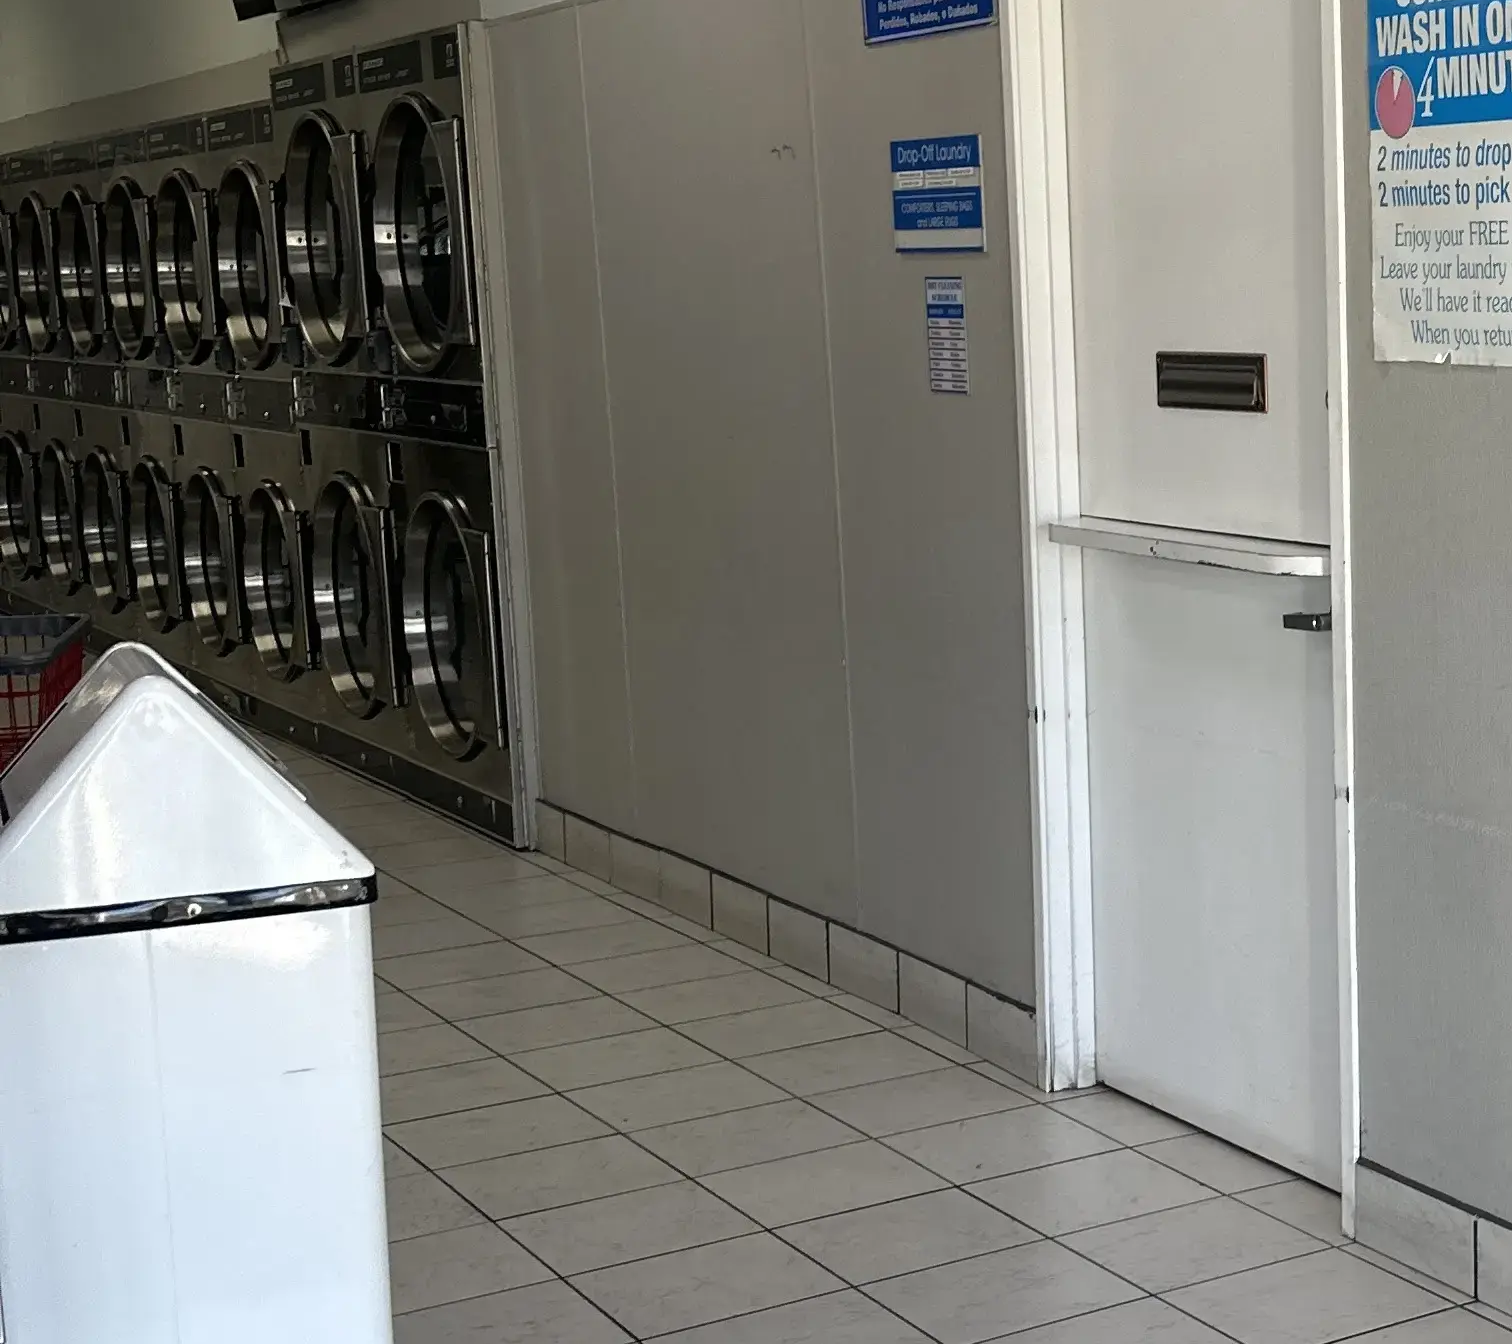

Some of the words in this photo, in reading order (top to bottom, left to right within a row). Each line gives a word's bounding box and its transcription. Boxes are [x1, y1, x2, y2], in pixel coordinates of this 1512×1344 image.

[1376, 8, 1446, 57] WASH
[1453, 4, 1479, 49] IN
[1417, 56, 1436, 117] 4
[897, 144, 934, 166] Drop-Off
[935, 142, 972, 162] Laundry
[1377, 145, 1387, 172] 2
[1390, 143, 1451, 171] minutes
[1456, 141, 1470, 168] to
[1475, 138, 1512, 171] drop
[1379, 181, 1388, 207] 2
[1392, 180, 1450, 207] minutes
[1456, 178, 1470, 205] to
[1475, 175, 1510, 210] pick
[1395, 223, 1431, 252] Enjoy
[1435, 228, 1464, 253] your
[1469, 220, 1509, 246] FREE
[1380, 255, 1418, 279] Leave
[1422, 261, 1452, 285] your
[1456, 254, 1507, 285] laundry
[1400, 287, 1433, 312] We'll
[1437, 287, 1469, 313] have
[1473, 288, 1482, 313] it
[1411, 320, 1450, 345] When
[1454, 328, 1479, 350] you
